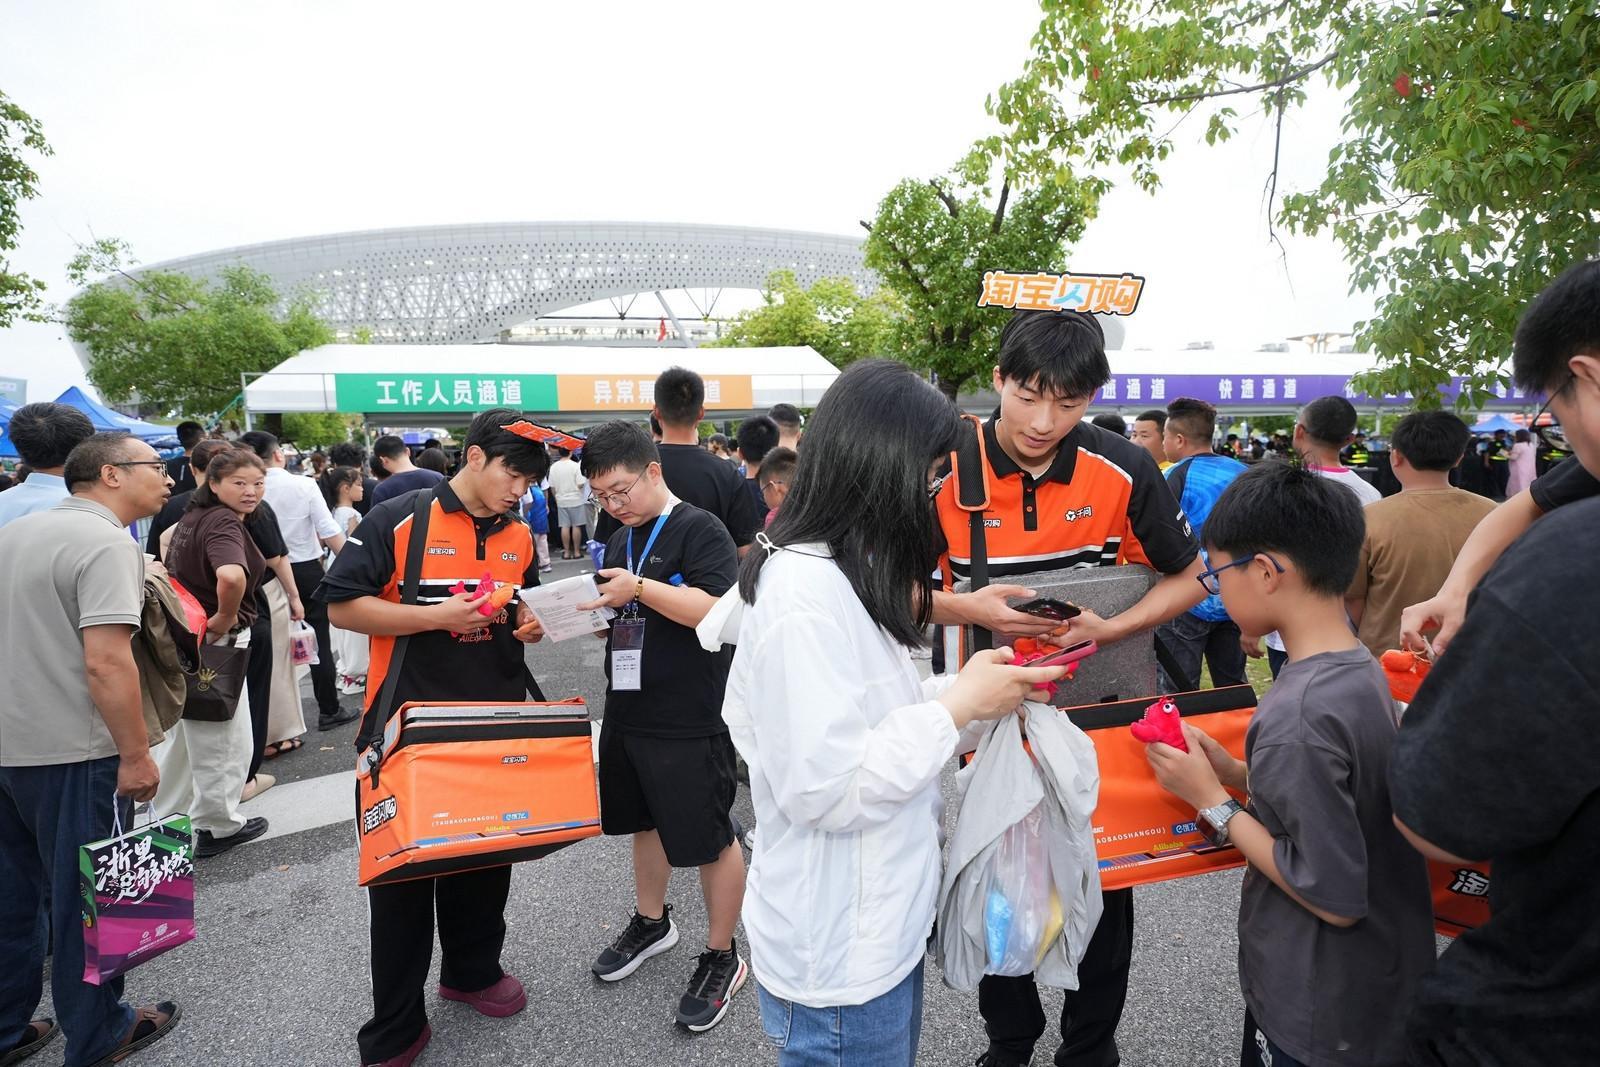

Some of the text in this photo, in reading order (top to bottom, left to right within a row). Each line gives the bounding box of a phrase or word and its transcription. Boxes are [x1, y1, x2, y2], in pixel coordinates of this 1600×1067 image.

[978, 271, 1141, 314] 淘宝闪购
[376, 379, 522, 405] 工作人员通道
[594, 379, 721, 404] 异常票道
[1218, 378, 1297, 399] 快速通道
